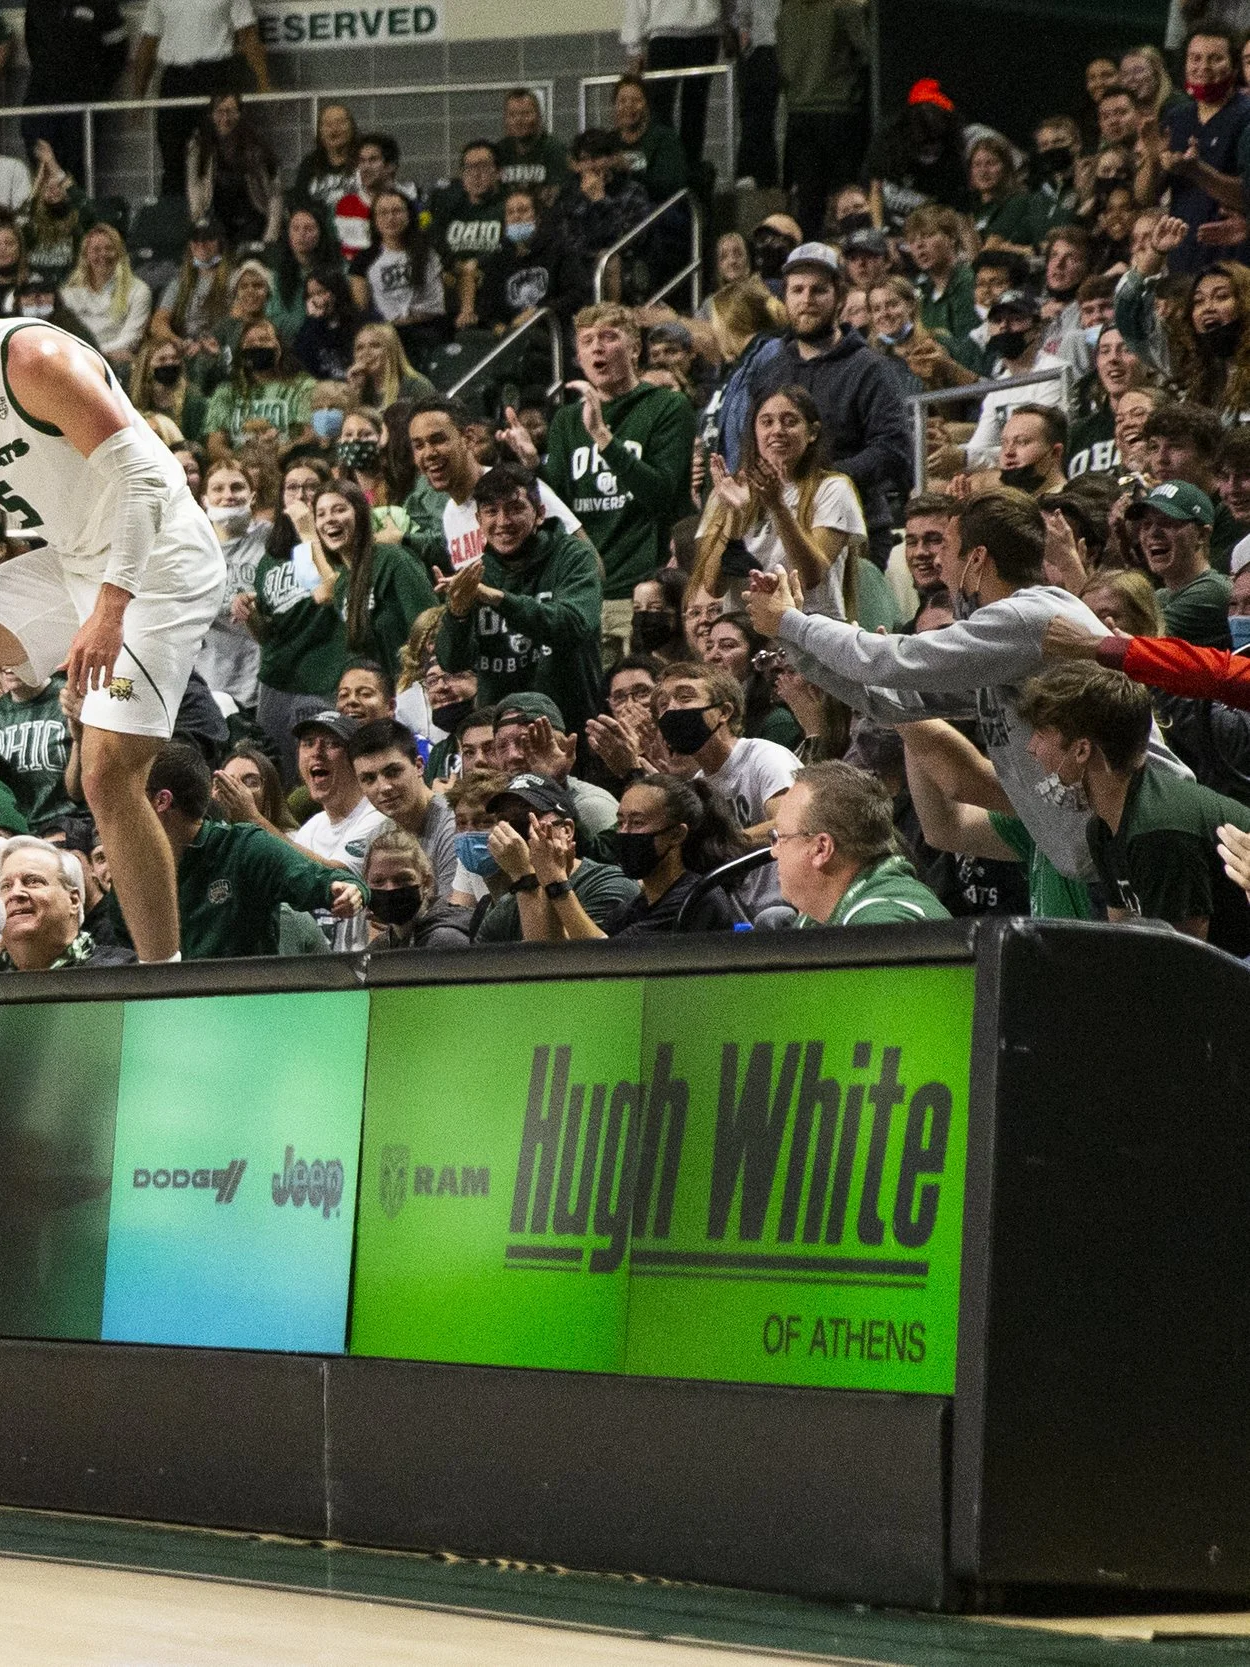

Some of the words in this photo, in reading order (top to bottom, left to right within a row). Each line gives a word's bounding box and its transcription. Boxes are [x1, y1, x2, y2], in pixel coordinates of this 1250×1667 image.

[257, 4, 438, 43] ESERVED
[133, 1167, 228, 1190] DODGE
[509, 1043, 689, 1274] Hugh
[706, 1041, 953, 1248] White
[271, 1144, 344, 1219] Jeep
[414, 1164, 491, 1198] RAM
[763, 1313, 801, 1355] OF
[808, 1316, 927, 1363] ATHENS
